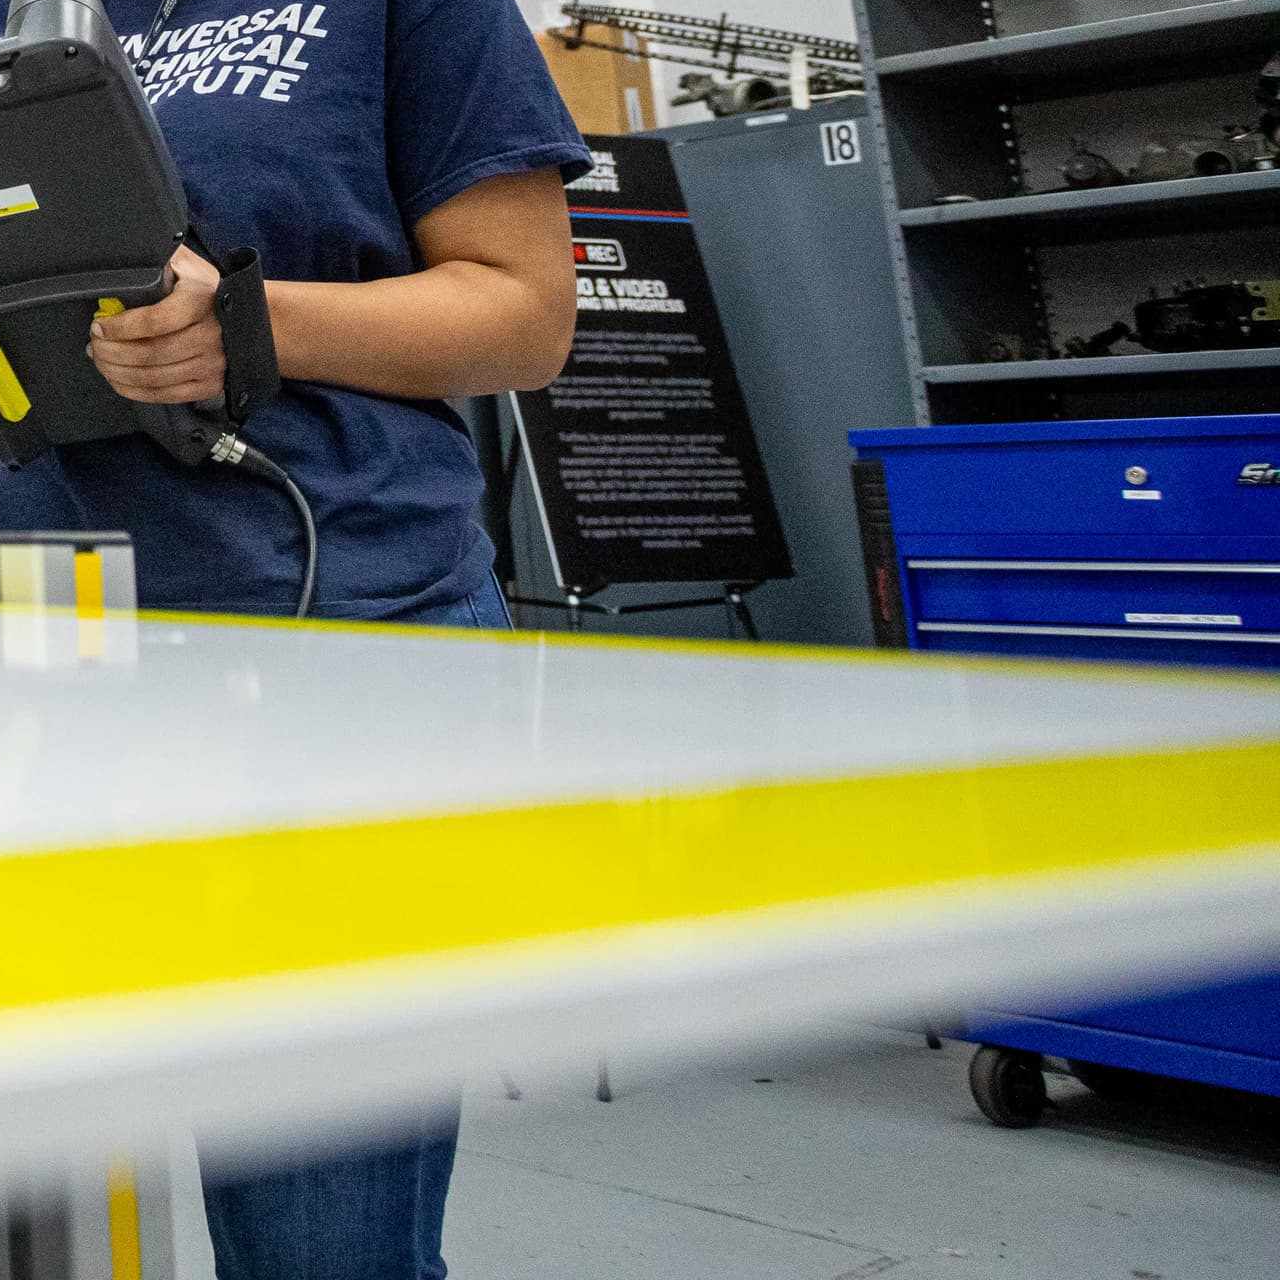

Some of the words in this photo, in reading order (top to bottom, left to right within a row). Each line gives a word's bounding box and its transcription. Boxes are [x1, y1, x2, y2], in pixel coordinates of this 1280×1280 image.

[118, 3, 328, 58] NIVERSAL
[143, 65, 301, 104] TITUTE
[825, 124, 855, 161] 18
[585, 245, 618, 263] REC
[595, 277, 612, 296] &
[610, 278, 669, 298] VIDEO
[601, 298, 618, 311] IN
[617, 298, 687, 313] PROGRESS
